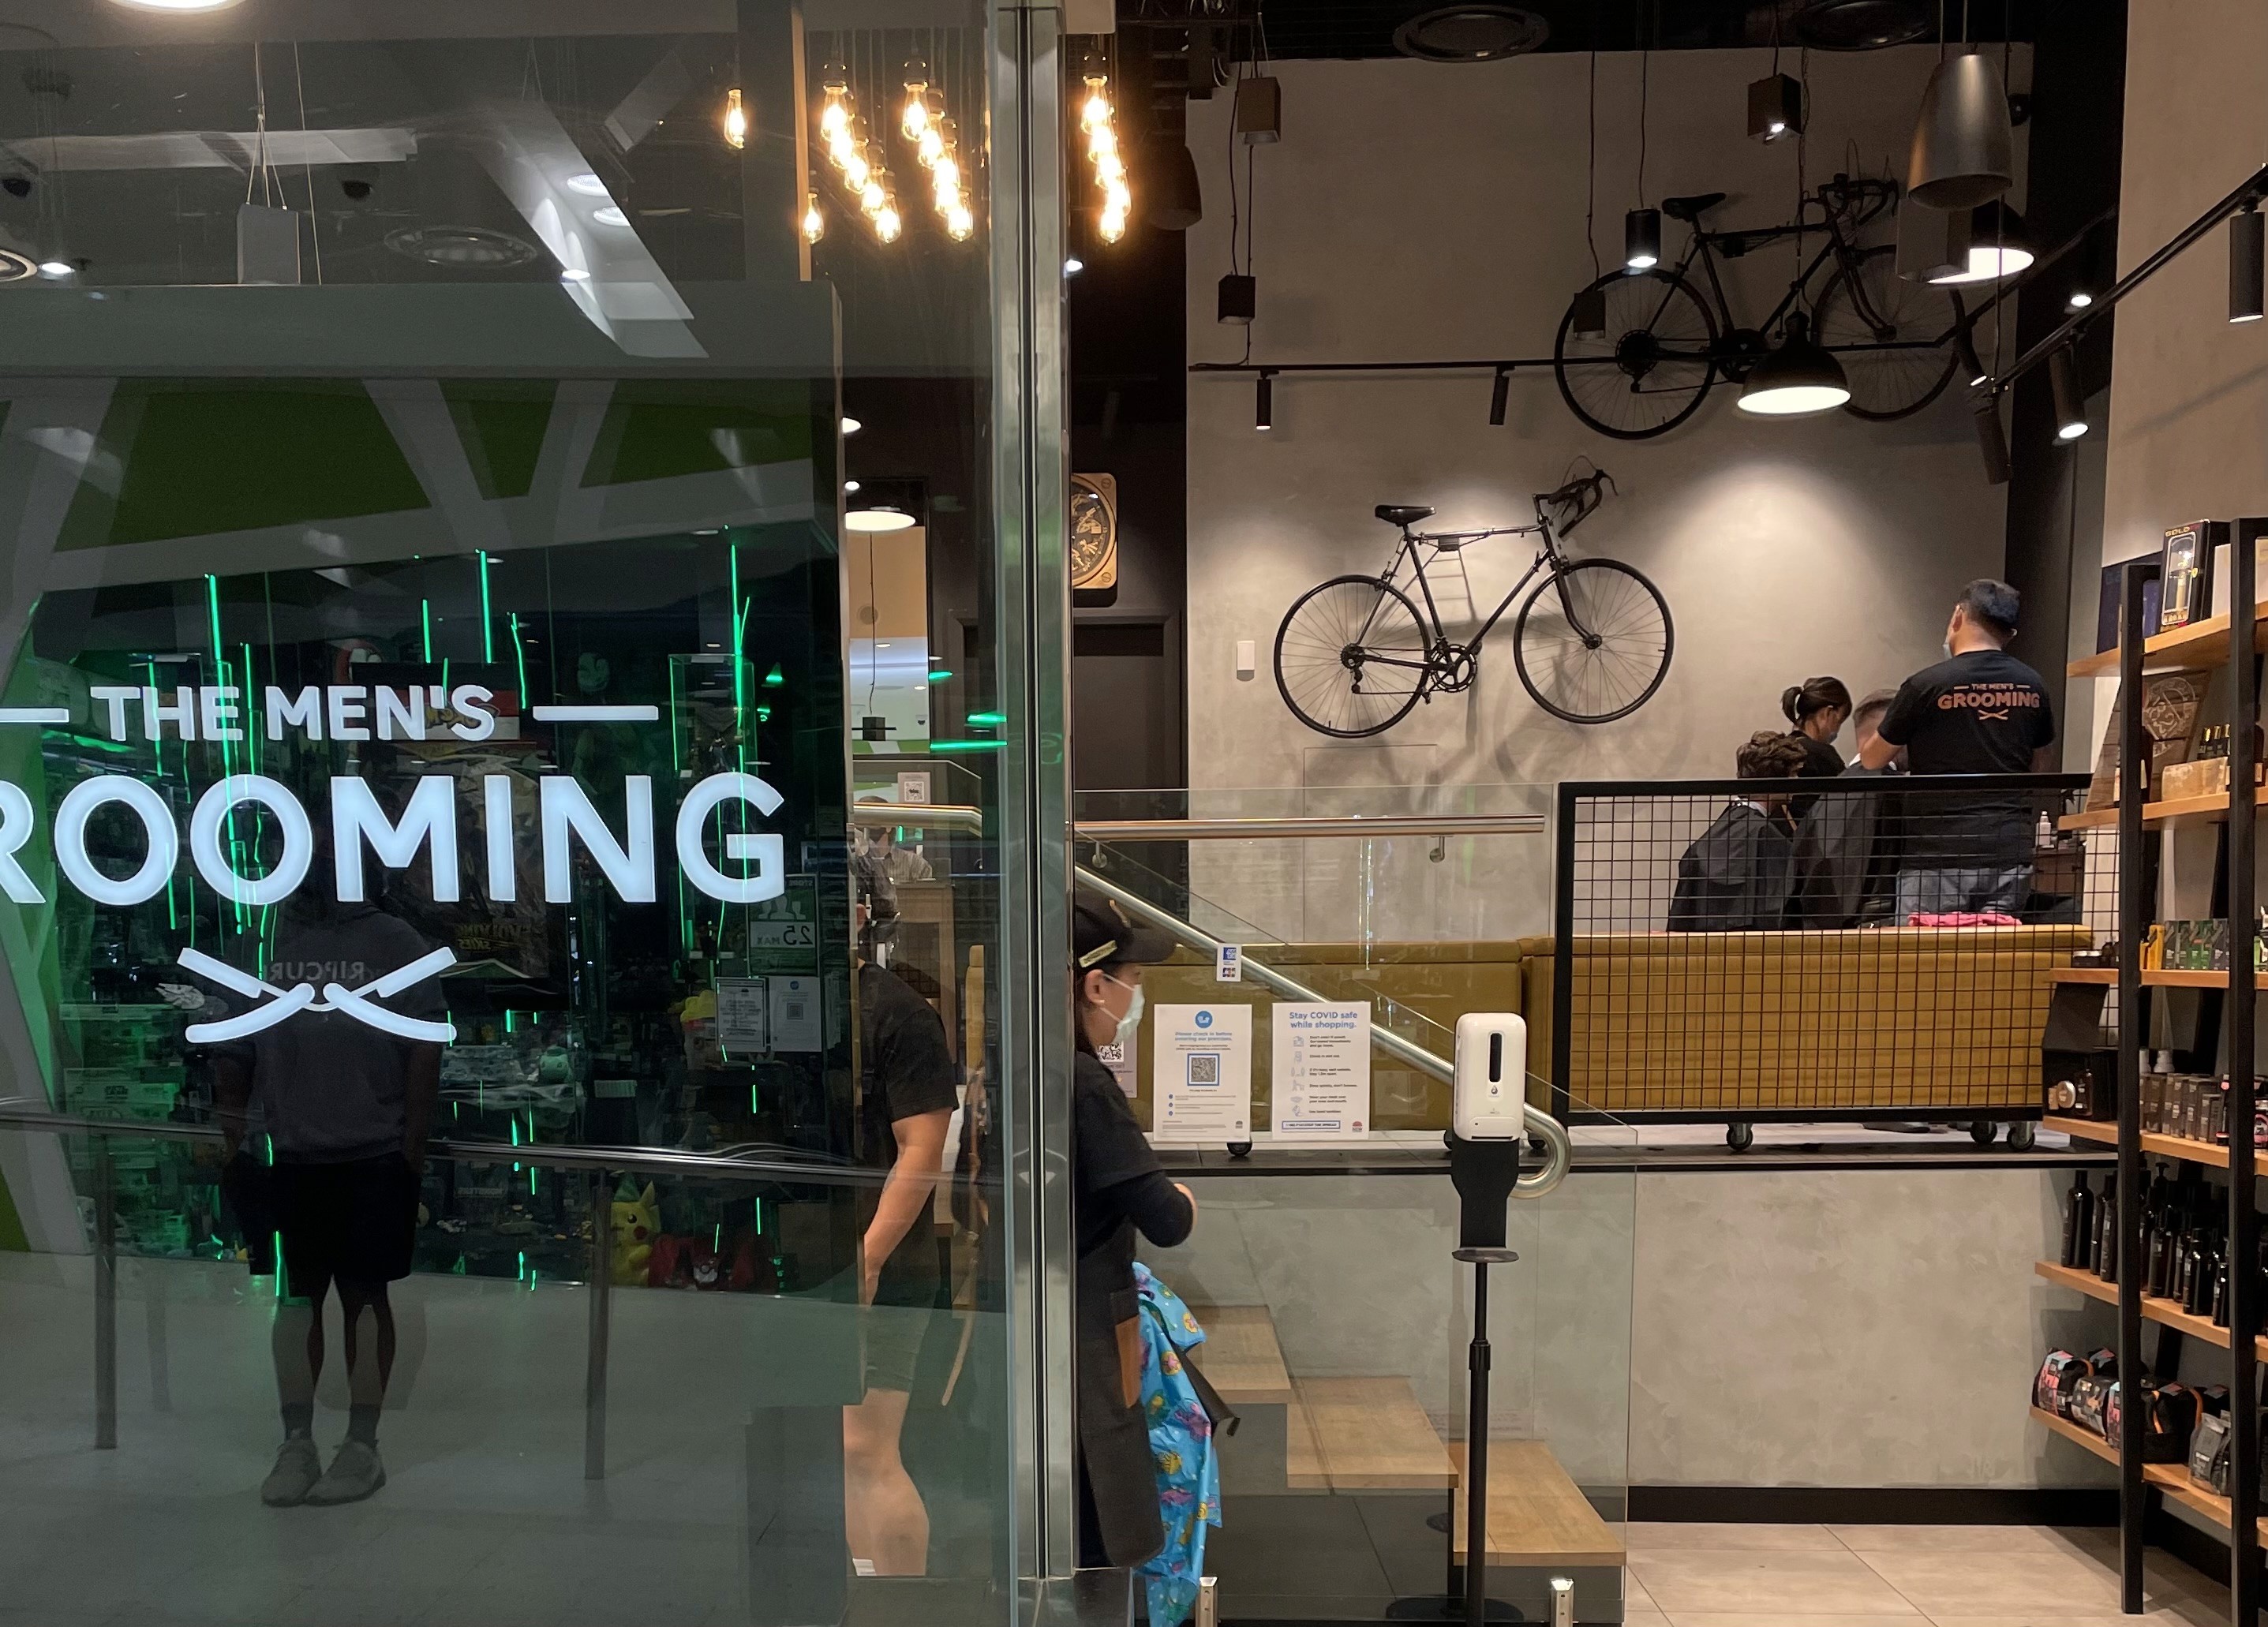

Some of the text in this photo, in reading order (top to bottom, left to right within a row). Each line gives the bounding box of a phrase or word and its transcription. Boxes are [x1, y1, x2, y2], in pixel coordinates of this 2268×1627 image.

[1937, 691, 2041, 709] GROOMING
[90, 685, 244, 742] THE
[264, 684, 496, 742] MEN'S
[1289, 1012, 1308, 1020] Stay
